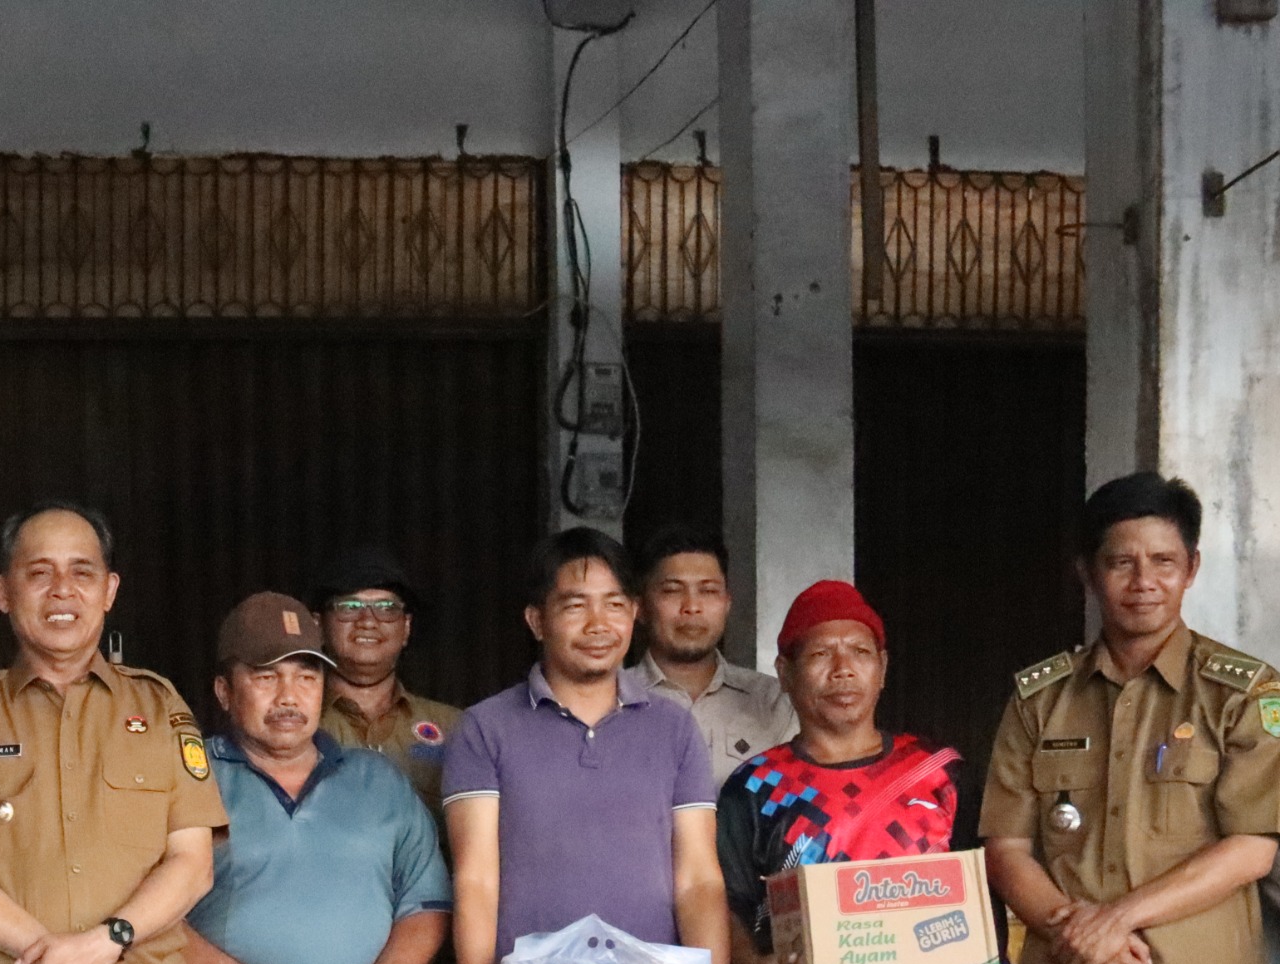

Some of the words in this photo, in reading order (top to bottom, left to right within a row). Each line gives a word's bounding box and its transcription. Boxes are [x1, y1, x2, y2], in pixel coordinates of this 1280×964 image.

[837, 920, 884, 931] Rasa
[924, 916, 955, 936] LEBIH
[838, 931, 896, 948] Kaldu
[919, 923, 967, 949] GURIH
